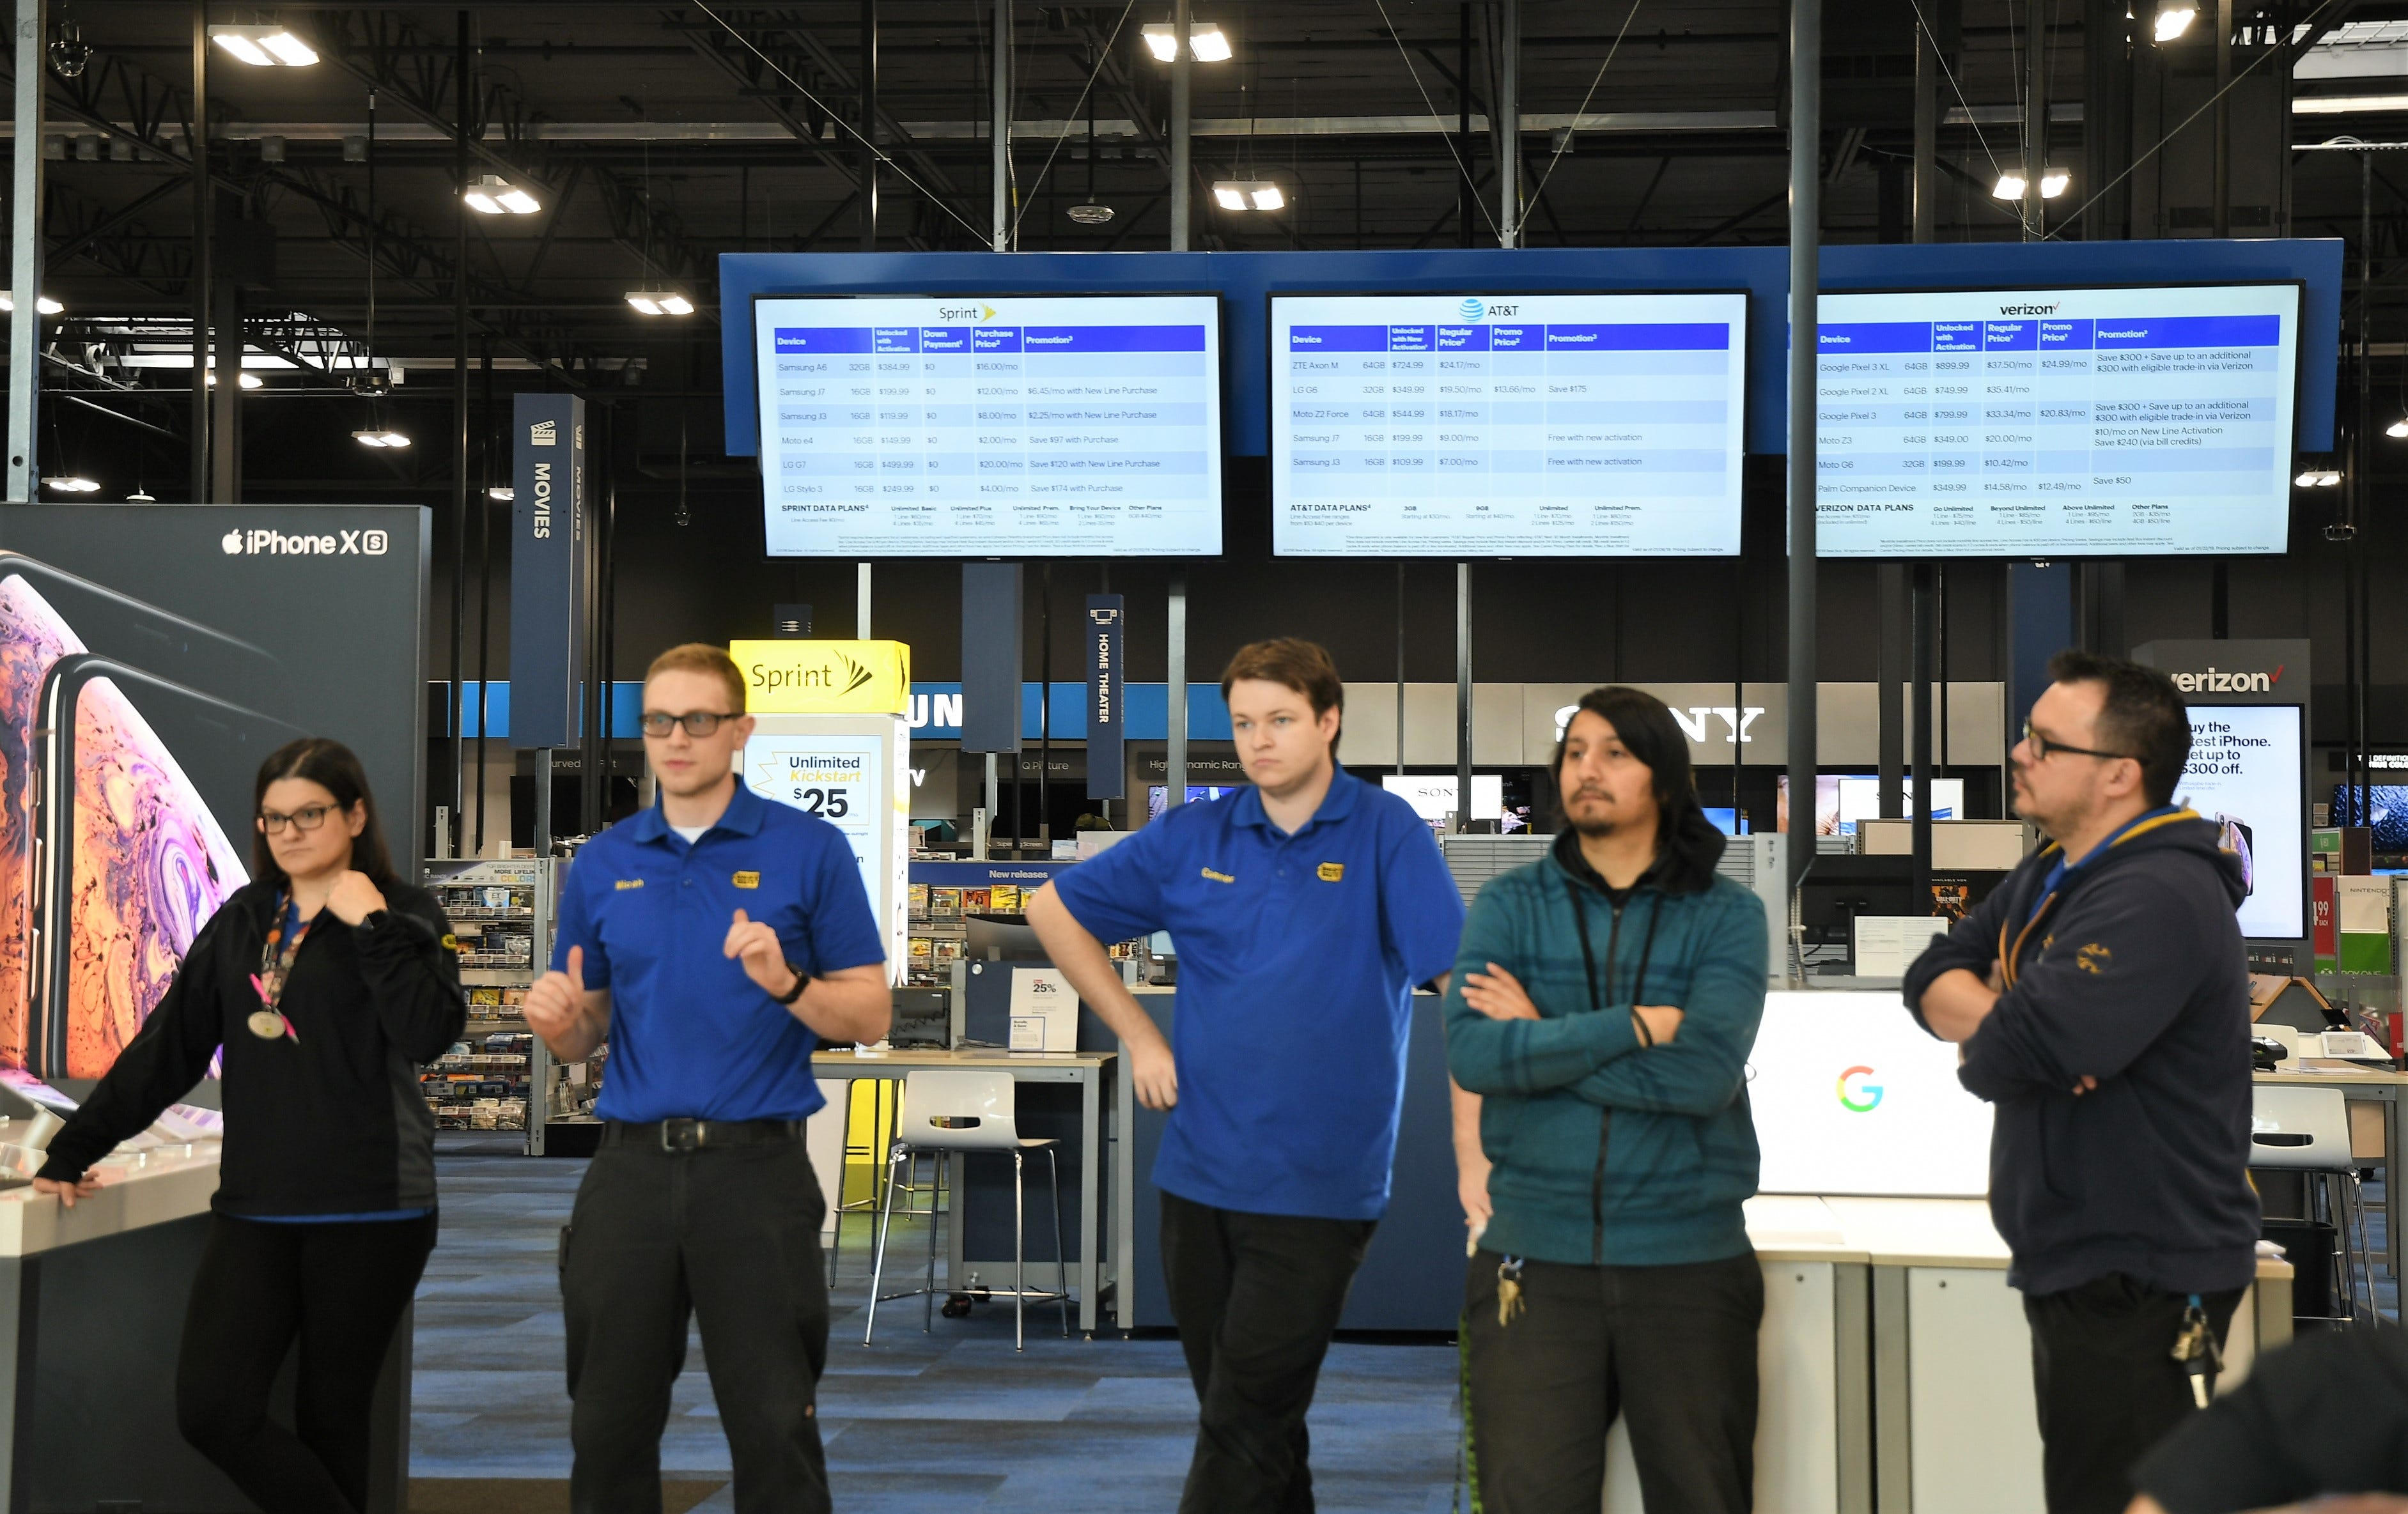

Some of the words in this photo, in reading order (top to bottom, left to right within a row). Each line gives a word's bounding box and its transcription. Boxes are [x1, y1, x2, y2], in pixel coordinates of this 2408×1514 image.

[940, 307, 977, 322] Sprint
[1488, 305, 1519, 316] AT&T
[2000, 303, 2053, 315] verizon
[1936, 323, 1974, 332] Unlocked
[1988, 323, 2023, 333] Regular
[2209, 351, 2251, 359] additional
[1820, 364, 1849, 373] Google
[2121, 364, 2139, 372] with
[2141, 364, 2171, 373] eligible
[2173, 362, 2205, 371] trade-in
[2221, 362, 2253, 370] Verizon
[1819, 412, 1849, 421] Google
[2140, 438, 2154, 447] (via
[2170, 437, 2202, 445] credits)
[1818, 484, 1838, 492] Palm
[534, 463, 551, 539] MOVIES
[247, 530, 336, 555] iPhone
[1098, 634, 1109, 670] HOME
[752, 664, 831, 693] Sprint
[1098, 672, 1109, 723] THEATER
[2189, 723, 2205, 734] uy
[2209, 722, 2230, 732] the
[2190, 736, 2216, 746] test
[2219, 736, 2271, 746] iPhone.
[2187, 750, 2203, 760] et
[2207, 752, 2224, 762] up
[2228, 750, 2241, 760] to
[551, 759, 581, 768] urved
[790, 757, 860, 768] Unlimited
[1023, 761, 1030, 770] Q
[1032, 761, 1069, 770] Piture
[1150, 760, 1169, 771] Hig
[2222, 762, 2243, 775] off.
[790, 770, 861, 782] Kickstart
[794, 788, 848, 818] $25
[989, 870, 1010, 879] New
[1011, 870, 1048, 879] releases
[1033, 984, 1057, 993] 25%
